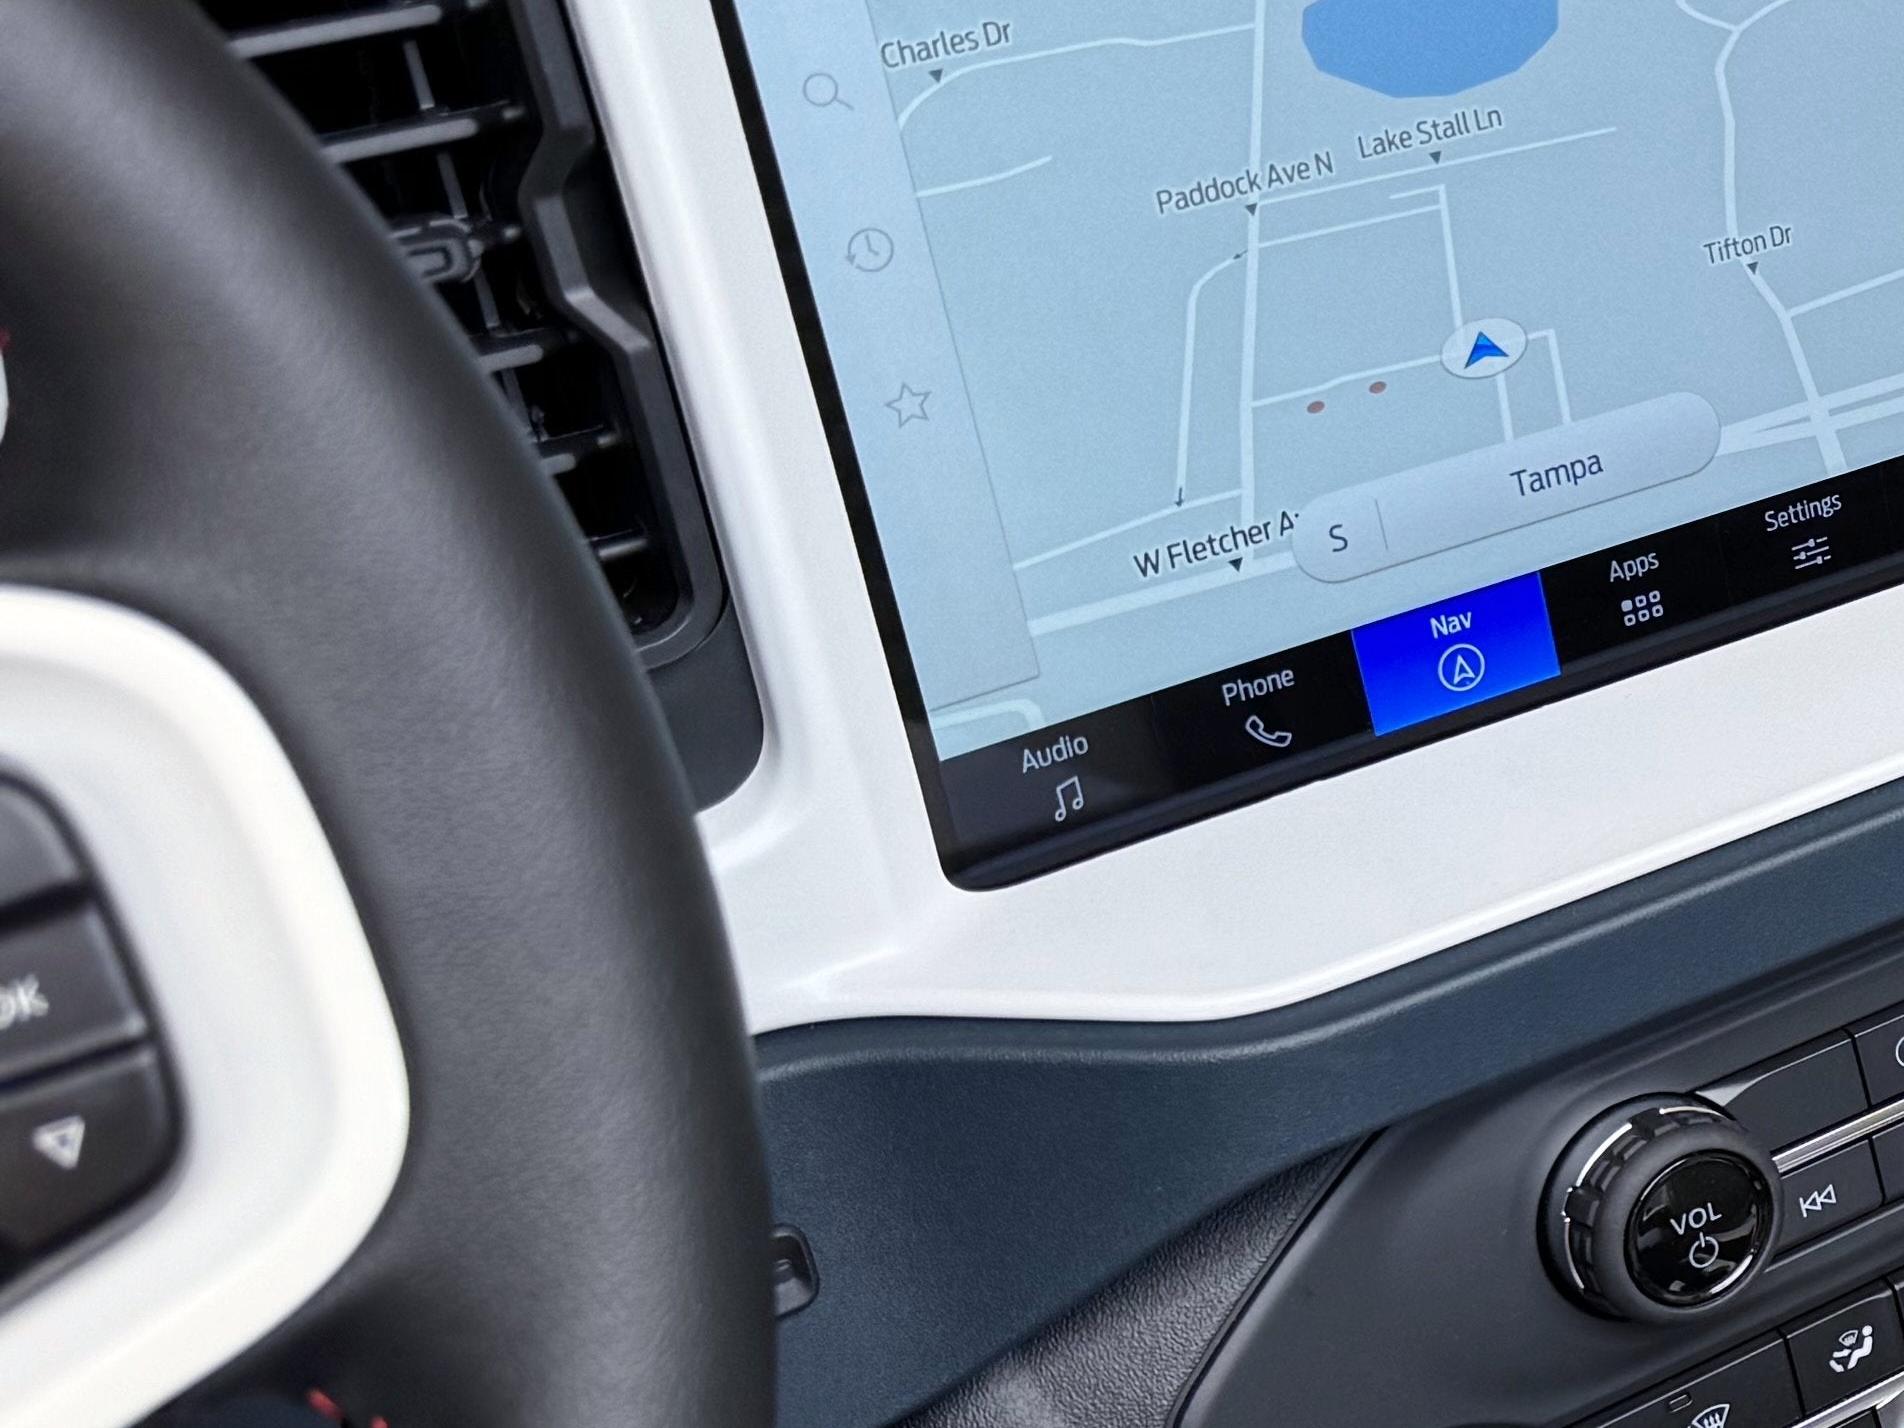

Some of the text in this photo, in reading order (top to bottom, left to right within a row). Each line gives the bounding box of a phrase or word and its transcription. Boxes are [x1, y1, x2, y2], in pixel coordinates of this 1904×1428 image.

[880, 21, 1012, 70] Charles Dr
[1357, 105, 1504, 161] Lake Stall Ln
[1156, 150, 1335, 216] Paddock Ave N
[1703, 224, 1793, 266] Tifton Dr
[1509, 449, 1604, 499] Tampa
[1763, 492, 1843, 534] Settings
[1133, 510, 1300, 578] W Fletcher A
[1328, 523, 1349, 553] S
[1608, 550, 1660, 584] Apps
[1429, 610, 1473, 640] Nav
[1221, 667, 1296, 708] Phone
[1020, 733, 1090, 775] Audio
[1669, 1201, 1723, 1238] VOL
